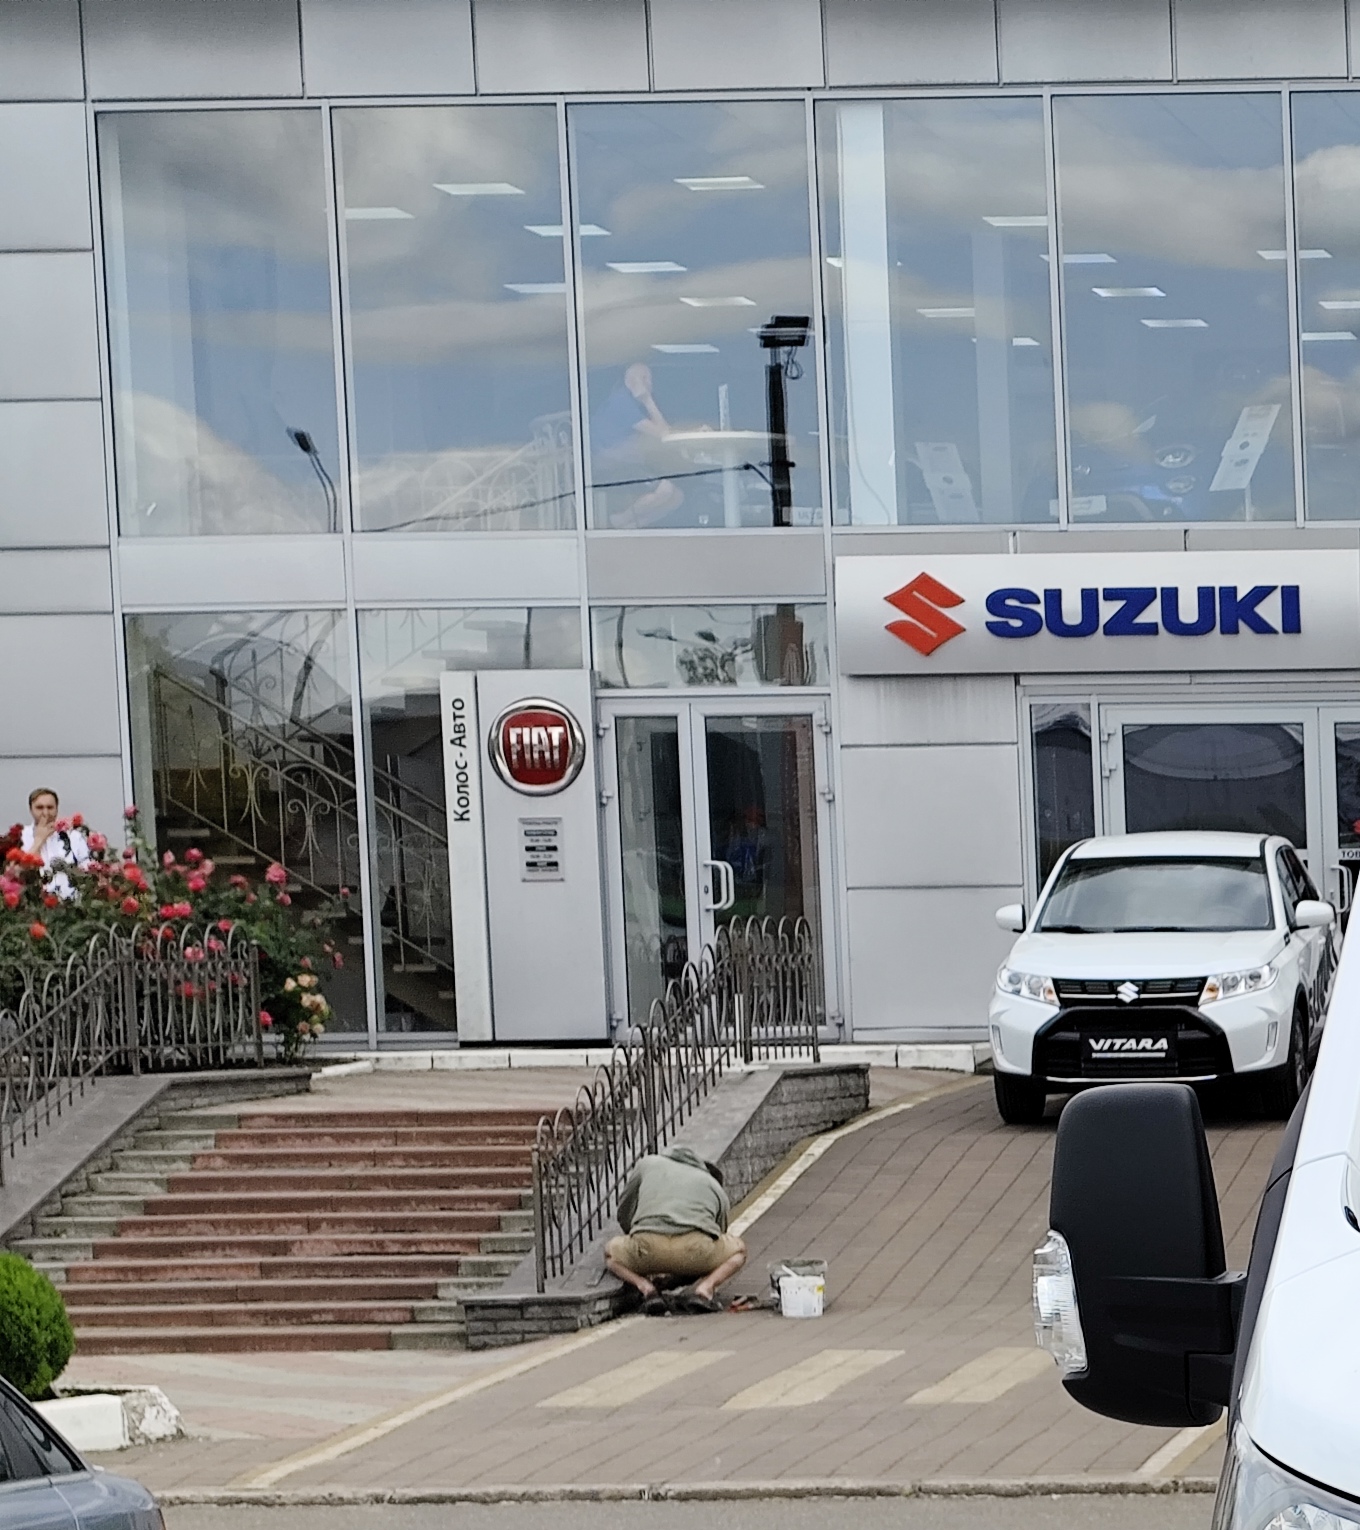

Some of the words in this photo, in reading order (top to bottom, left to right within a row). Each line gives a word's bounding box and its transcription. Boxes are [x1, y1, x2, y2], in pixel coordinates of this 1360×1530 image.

[984, 584, 1302, 638] SUZUKI
[450, 697, 471, 822] Колос-Авто
[508, 726, 565, 770] FIAT
[1088, 1037, 1169, 1051] VITARA
